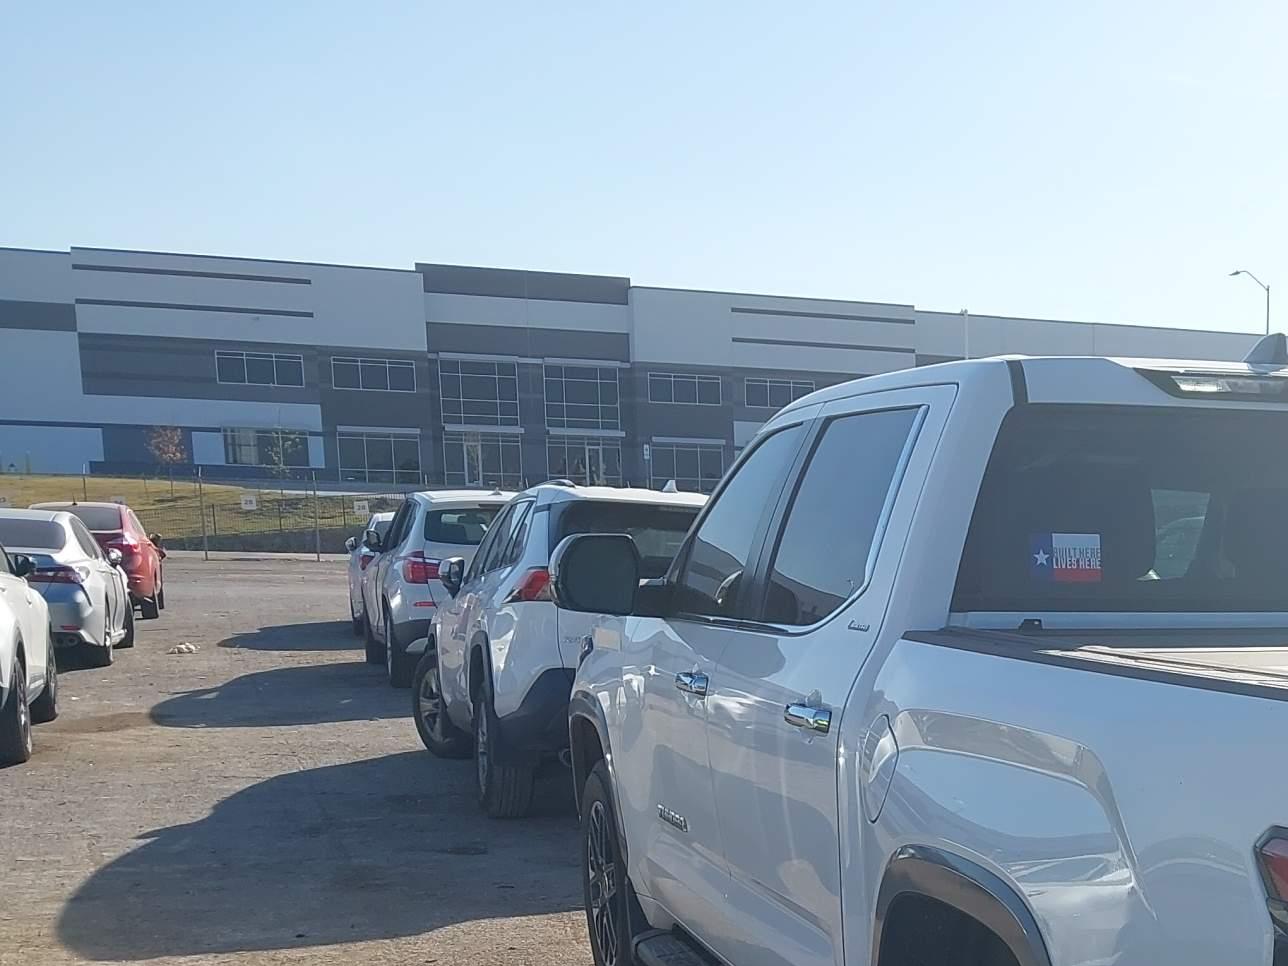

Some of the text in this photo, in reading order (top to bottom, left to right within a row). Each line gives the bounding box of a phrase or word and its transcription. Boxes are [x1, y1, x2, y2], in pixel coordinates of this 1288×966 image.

[1053, 547, 1101, 558] BUILT HERE
[1053, 557, 1101, 569] LIVES HERE
